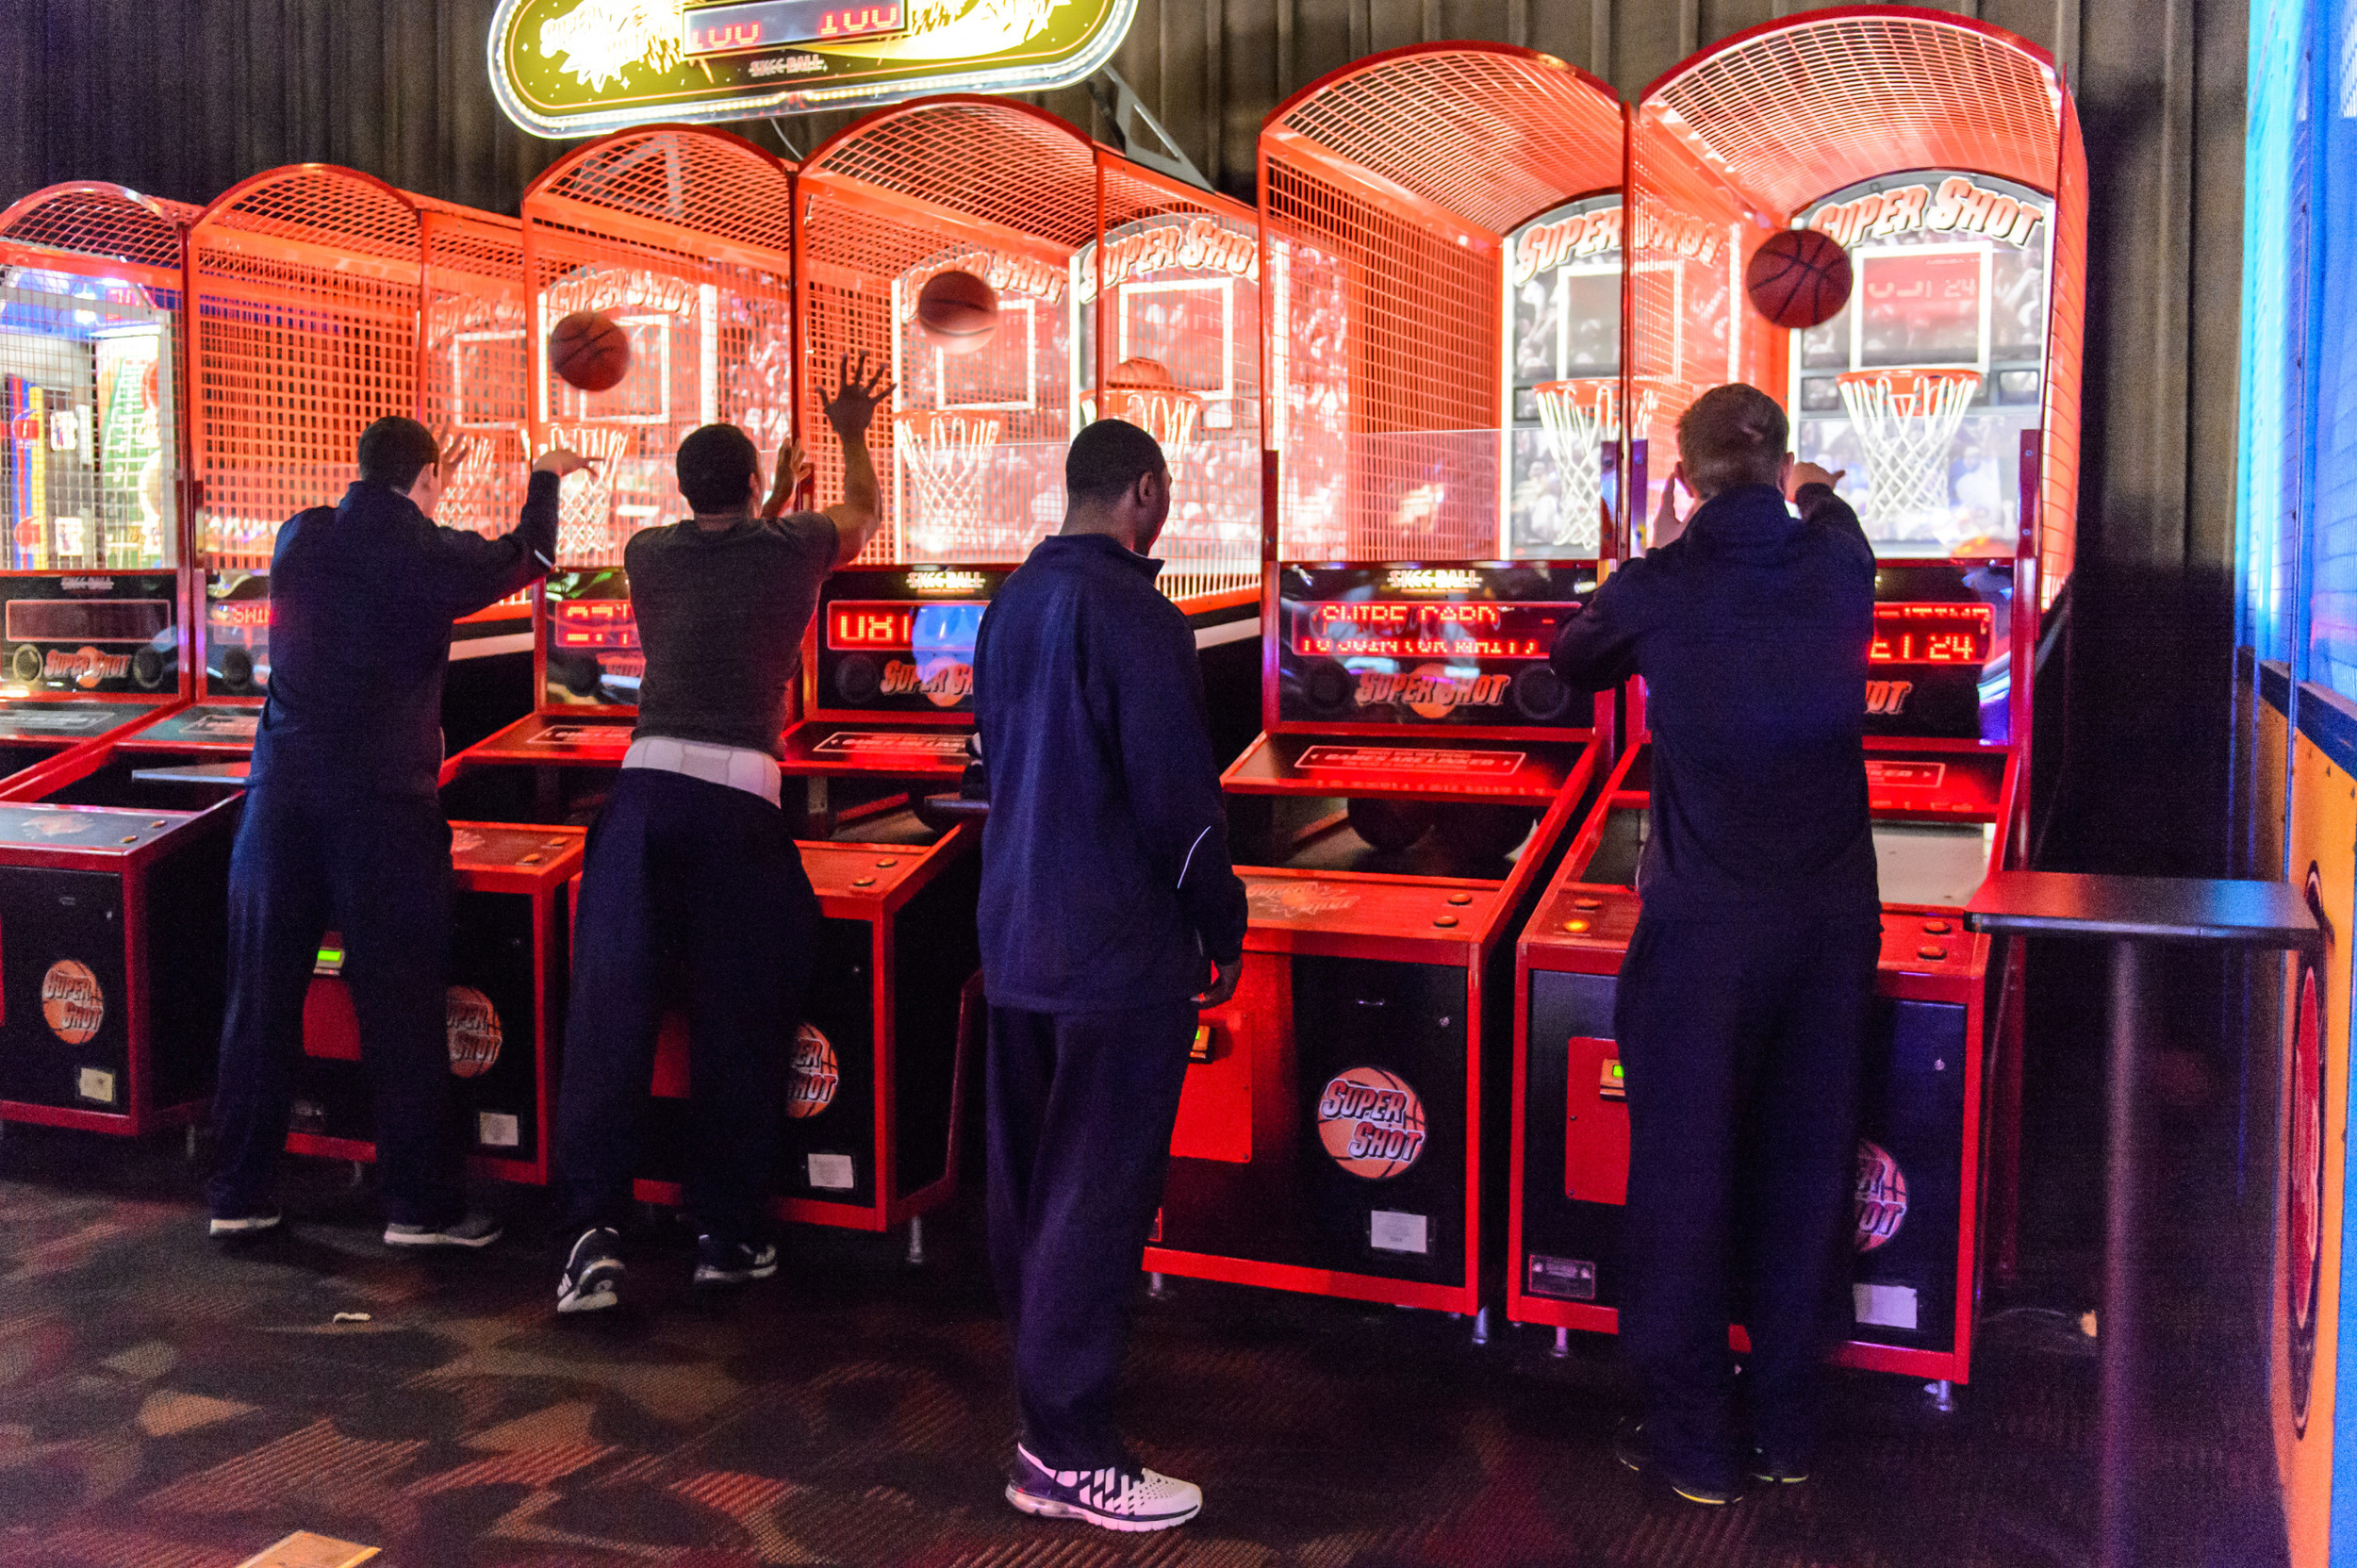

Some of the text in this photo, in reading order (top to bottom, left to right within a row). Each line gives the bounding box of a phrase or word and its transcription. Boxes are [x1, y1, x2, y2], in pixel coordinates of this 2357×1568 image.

[1925, 176, 2046, 249] SHOT
[1513, 206, 1623, 286] SUPER
[1354, 671, 1511, 706] SUPER SHOT
[1865, 680, 1913, 715] OT
[43, 968, 93, 1002] SUPER
[61, 1000, 103, 1031] SHOT
[1320, 1078, 1409, 1125] SUPER
[1347, 1120, 1426, 1163] SHOT
